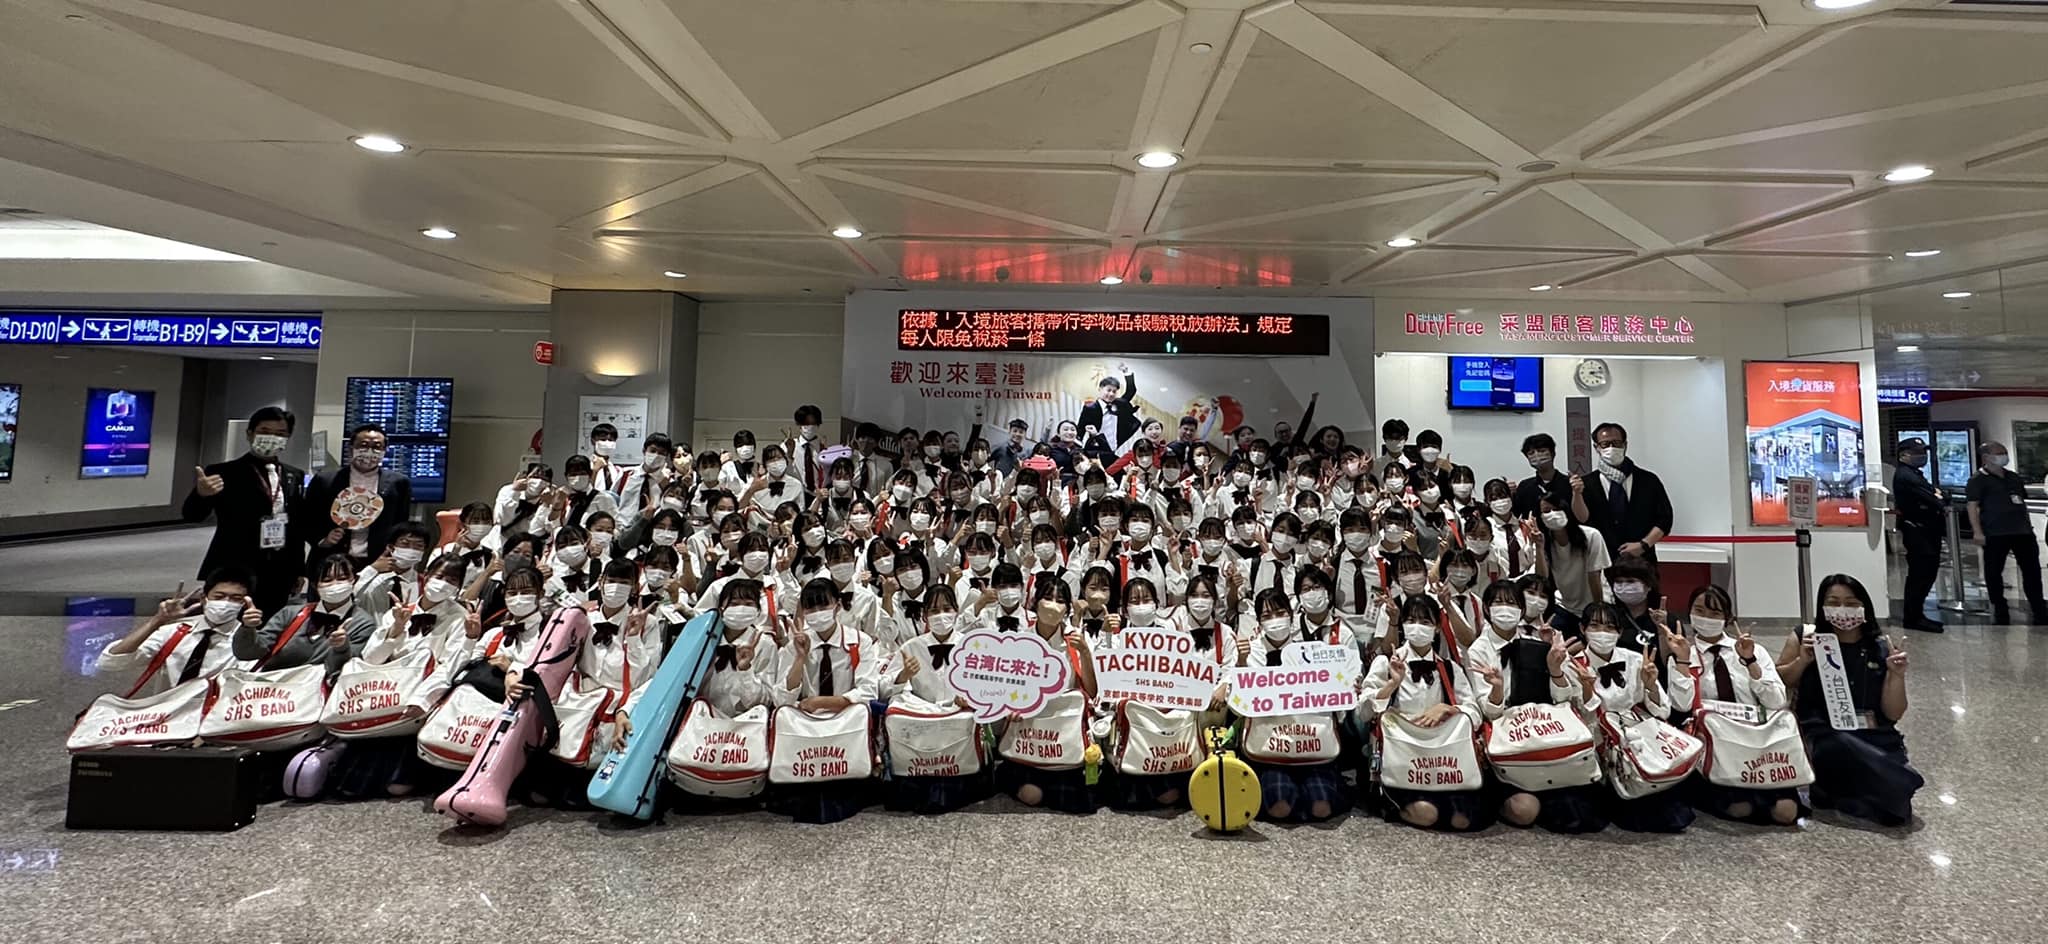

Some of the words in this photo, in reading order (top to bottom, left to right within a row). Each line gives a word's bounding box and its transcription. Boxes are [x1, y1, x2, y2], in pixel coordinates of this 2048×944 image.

[9, 321, 55, 340] D1-D10
[159, 323, 205, 342] B1-B9
[1406, 312, 1484, 340] DutyFree
[890, 361, 1025, 386] 歡迎來臺灣
[920, 387, 982, 399] Welcome
[984, 388, 1000, 399] To
[1002, 389, 1052, 400] Taiwan
[1125, 632, 1191, 654] KYOTO
[1096, 654, 1214, 684] TACHIBANA
[1135, 678, 1151, 687] SHS
[1152, 679, 1175, 689] BAND
[1237, 669, 1330, 689] Welcome
[233, 686, 291, 705] TACHIBANA
[344, 679, 398, 700] TACHIBANA
[224, 704, 253, 722] SHS
[261, 700, 296, 717] BAND
[338, 698, 364, 715] SHS
[370, 692, 400, 711] BAND
[1252, 696, 1274, 712] to
[1278, 691, 1353, 710] Taiwan
[443, 726, 469, 744] SHS
[1272, 724, 1317, 738] TACHIBANA
[1509, 725, 1531, 743] SHS
[1533, 720, 1565, 737] BAND
[693, 745, 717, 763] SHS
[721, 748, 749, 764] BAND
[797, 745, 846, 762] TACHIBANA
[1015, 739, 1035, 756] SHS
[1038, 743, 1063, 759] BAND
[1269, 737, 1291, 753] SHS
[1295, 738, 1322, 754] BAND
[792, 762, 816, 777] SHS
[821, 760, 848, 777] BAND
[1143, 757, 1167, 773] SHS
[1410, 755, 1458, 770] TACHIBANA
[1743, 751, 1789, 771] TACHIBANA
[1407, 769, 1432, 785] SHS
[1436, 769, 1464, 785] BAND
[1741, 770, 1766, 784] SHS
[1769, 765, 1797, 783] BAND
